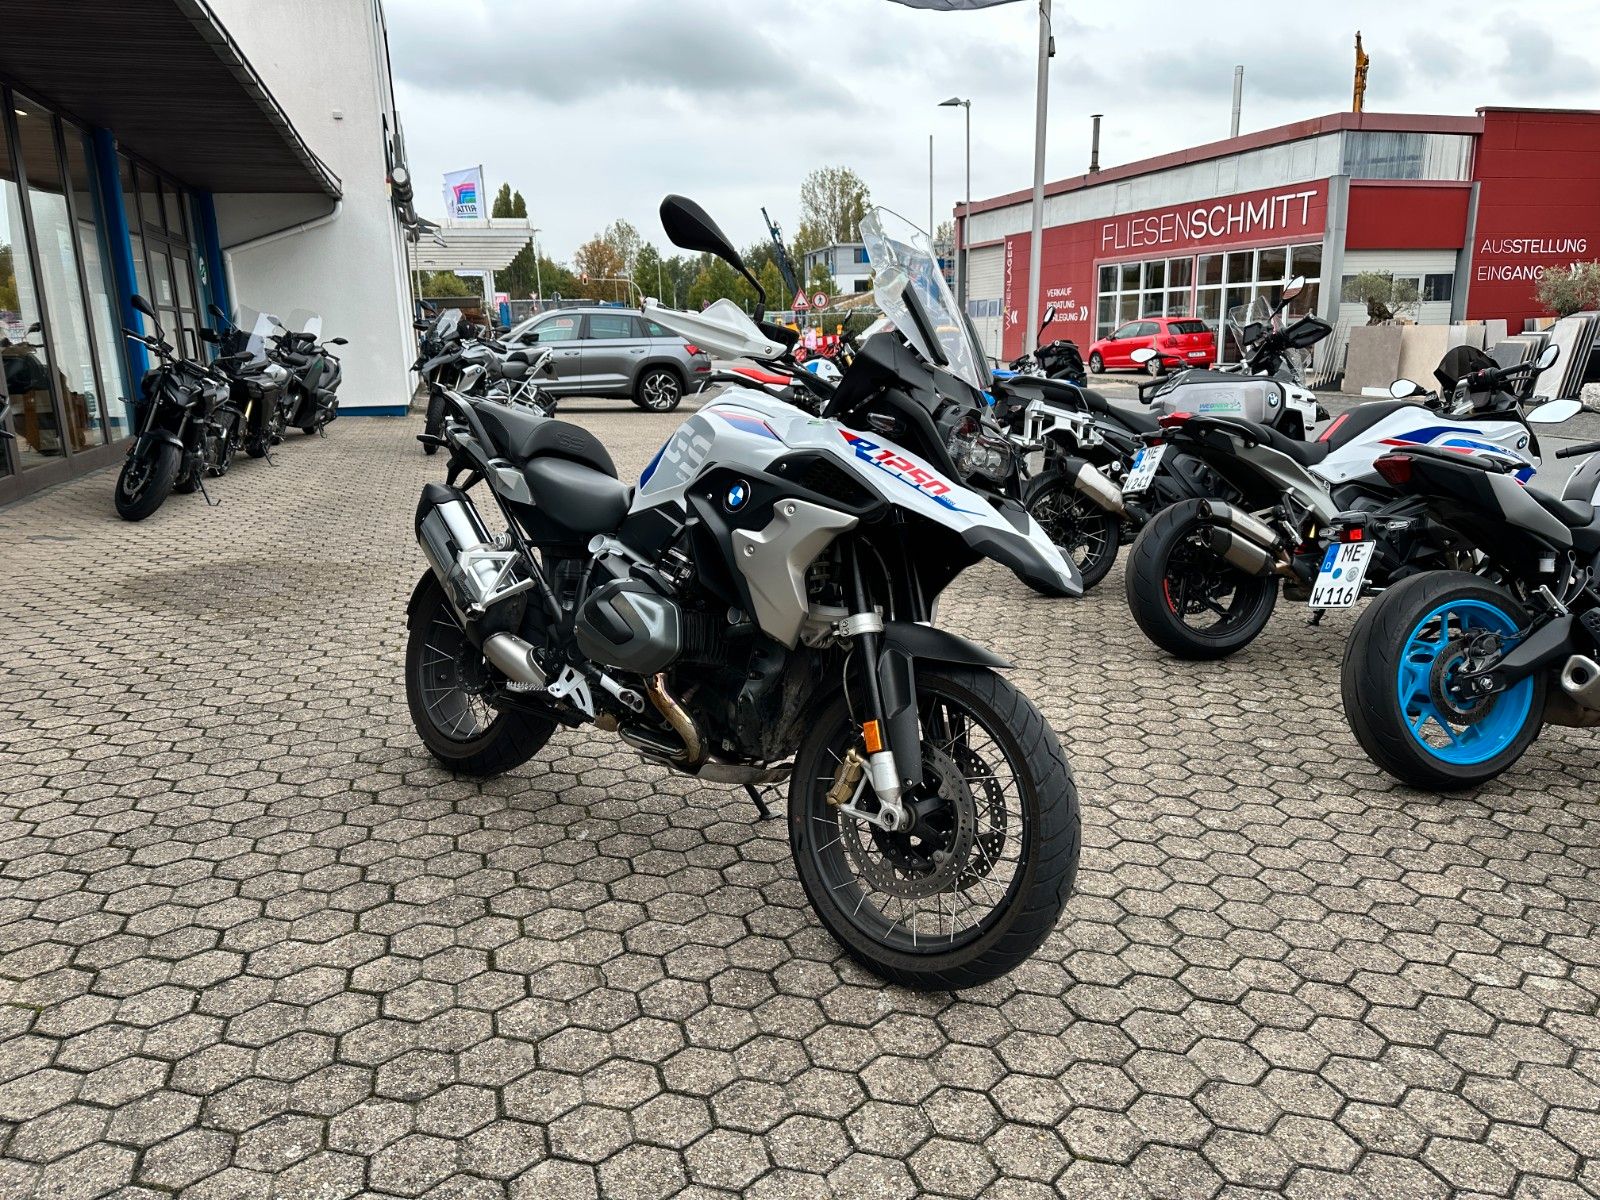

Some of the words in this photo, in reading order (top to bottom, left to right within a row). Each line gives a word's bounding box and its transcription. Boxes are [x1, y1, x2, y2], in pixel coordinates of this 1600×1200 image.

[1102, 190, 1317, 251] FLIESENSCHMITT
[1480, 239, 1587, 254] AUSSTELLUNG
[1477, 265, 1544, 281] EINGANG
[1046, 287, 1072, 297] VERKAUF
[1051, 313, 1078, 322] RLEGUNG
[1341, 544, 1365, 562] ME
[1312, 587, 1325, 605] W
[1323, 587, 1354, 605] 116
